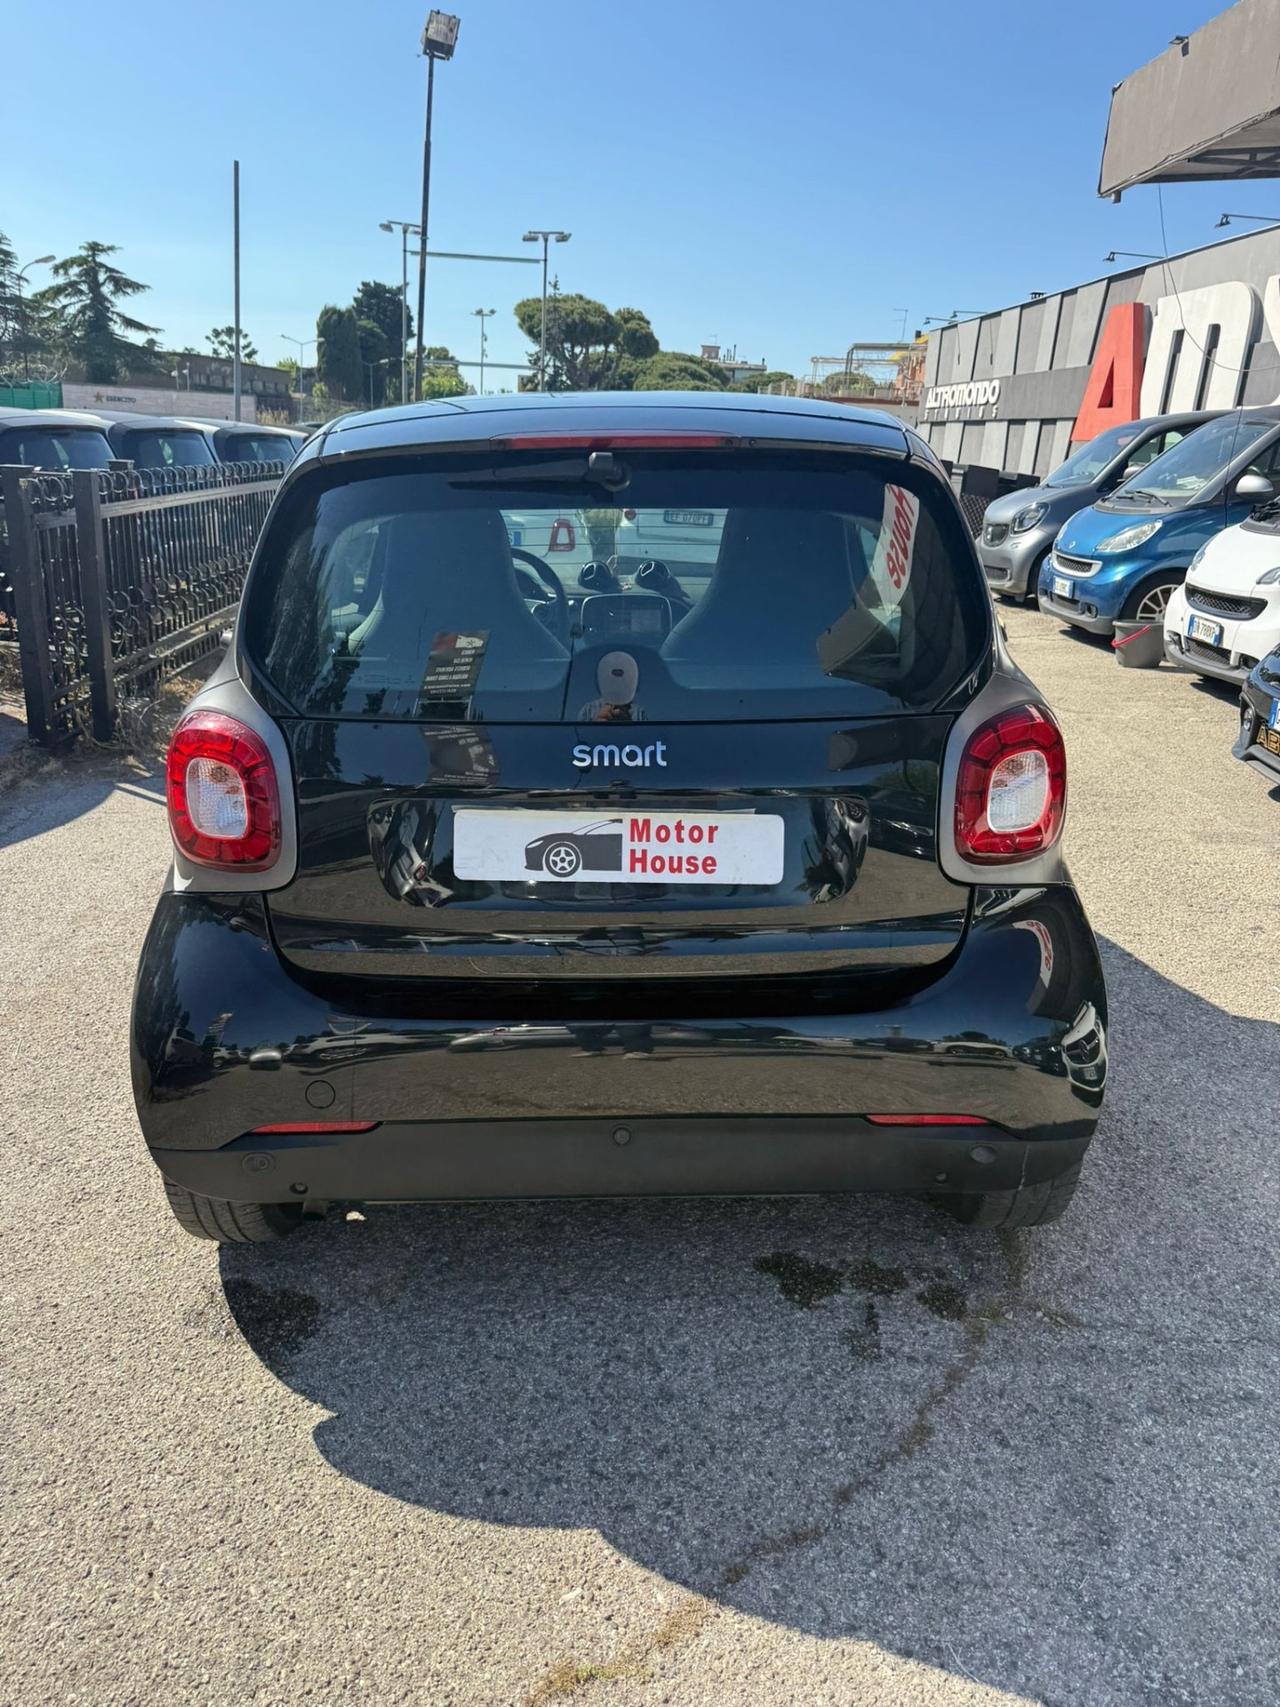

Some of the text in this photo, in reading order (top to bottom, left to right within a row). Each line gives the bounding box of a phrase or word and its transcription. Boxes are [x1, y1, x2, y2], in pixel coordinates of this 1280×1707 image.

[925, 379, 1000, 409] ALTROMONDO
[572, 740, 667, 767] smart
[630, 818, 719, 844] Motor
[629, 849, 718, 875] House
